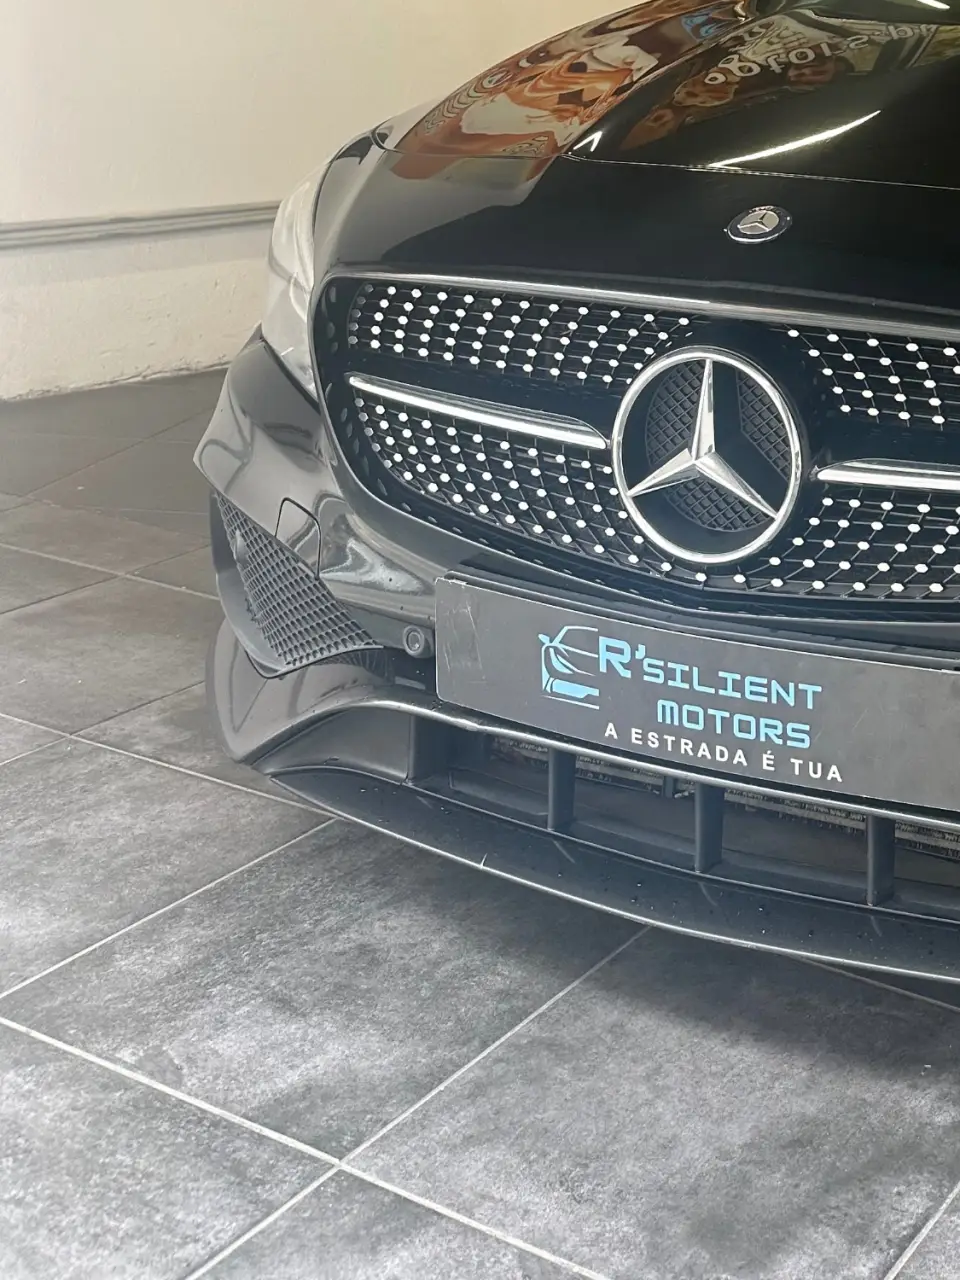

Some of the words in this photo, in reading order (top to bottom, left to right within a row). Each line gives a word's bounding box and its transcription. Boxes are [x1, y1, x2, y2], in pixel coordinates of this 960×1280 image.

[598, 635, 823, 710] R'SILIENT
[604, 723, 619, 740] A
[631, 728, 748, 768] ESTRADA
[761, 750, 776, 772] É
[791, 757, 844, 784] TUA
[657, 698, 812, 749] MOTORS
